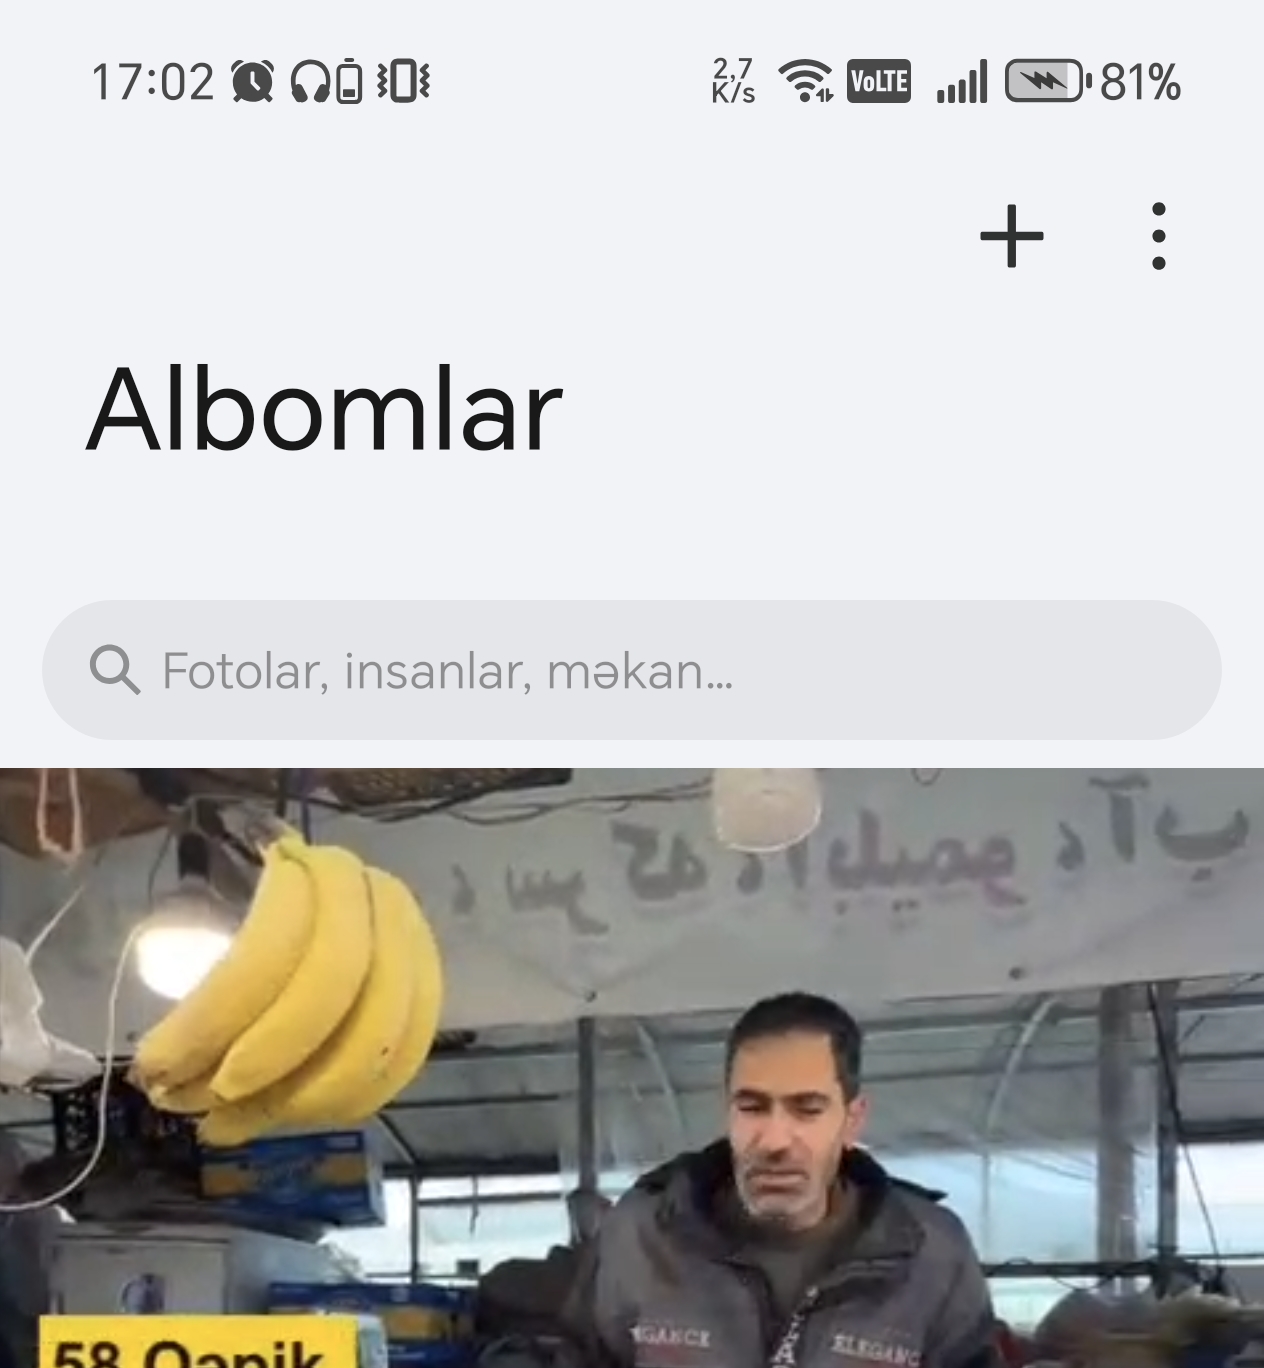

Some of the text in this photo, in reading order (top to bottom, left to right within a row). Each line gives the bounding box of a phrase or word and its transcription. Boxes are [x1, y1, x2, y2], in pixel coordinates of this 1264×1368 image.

[93, 62, 214, 101] 17:02
[713, 57, 753, 82] 2,7
[851, 69, 907, 93] VoLTE
[1100, 62, 1182, 101] 81%
[712, 82, 756, 104] K/s
[84, 363, 564, 452] Albomlar
[164, 650, 328, 696] Fotolar,
[346, 650, 531, 696] insanlar,
